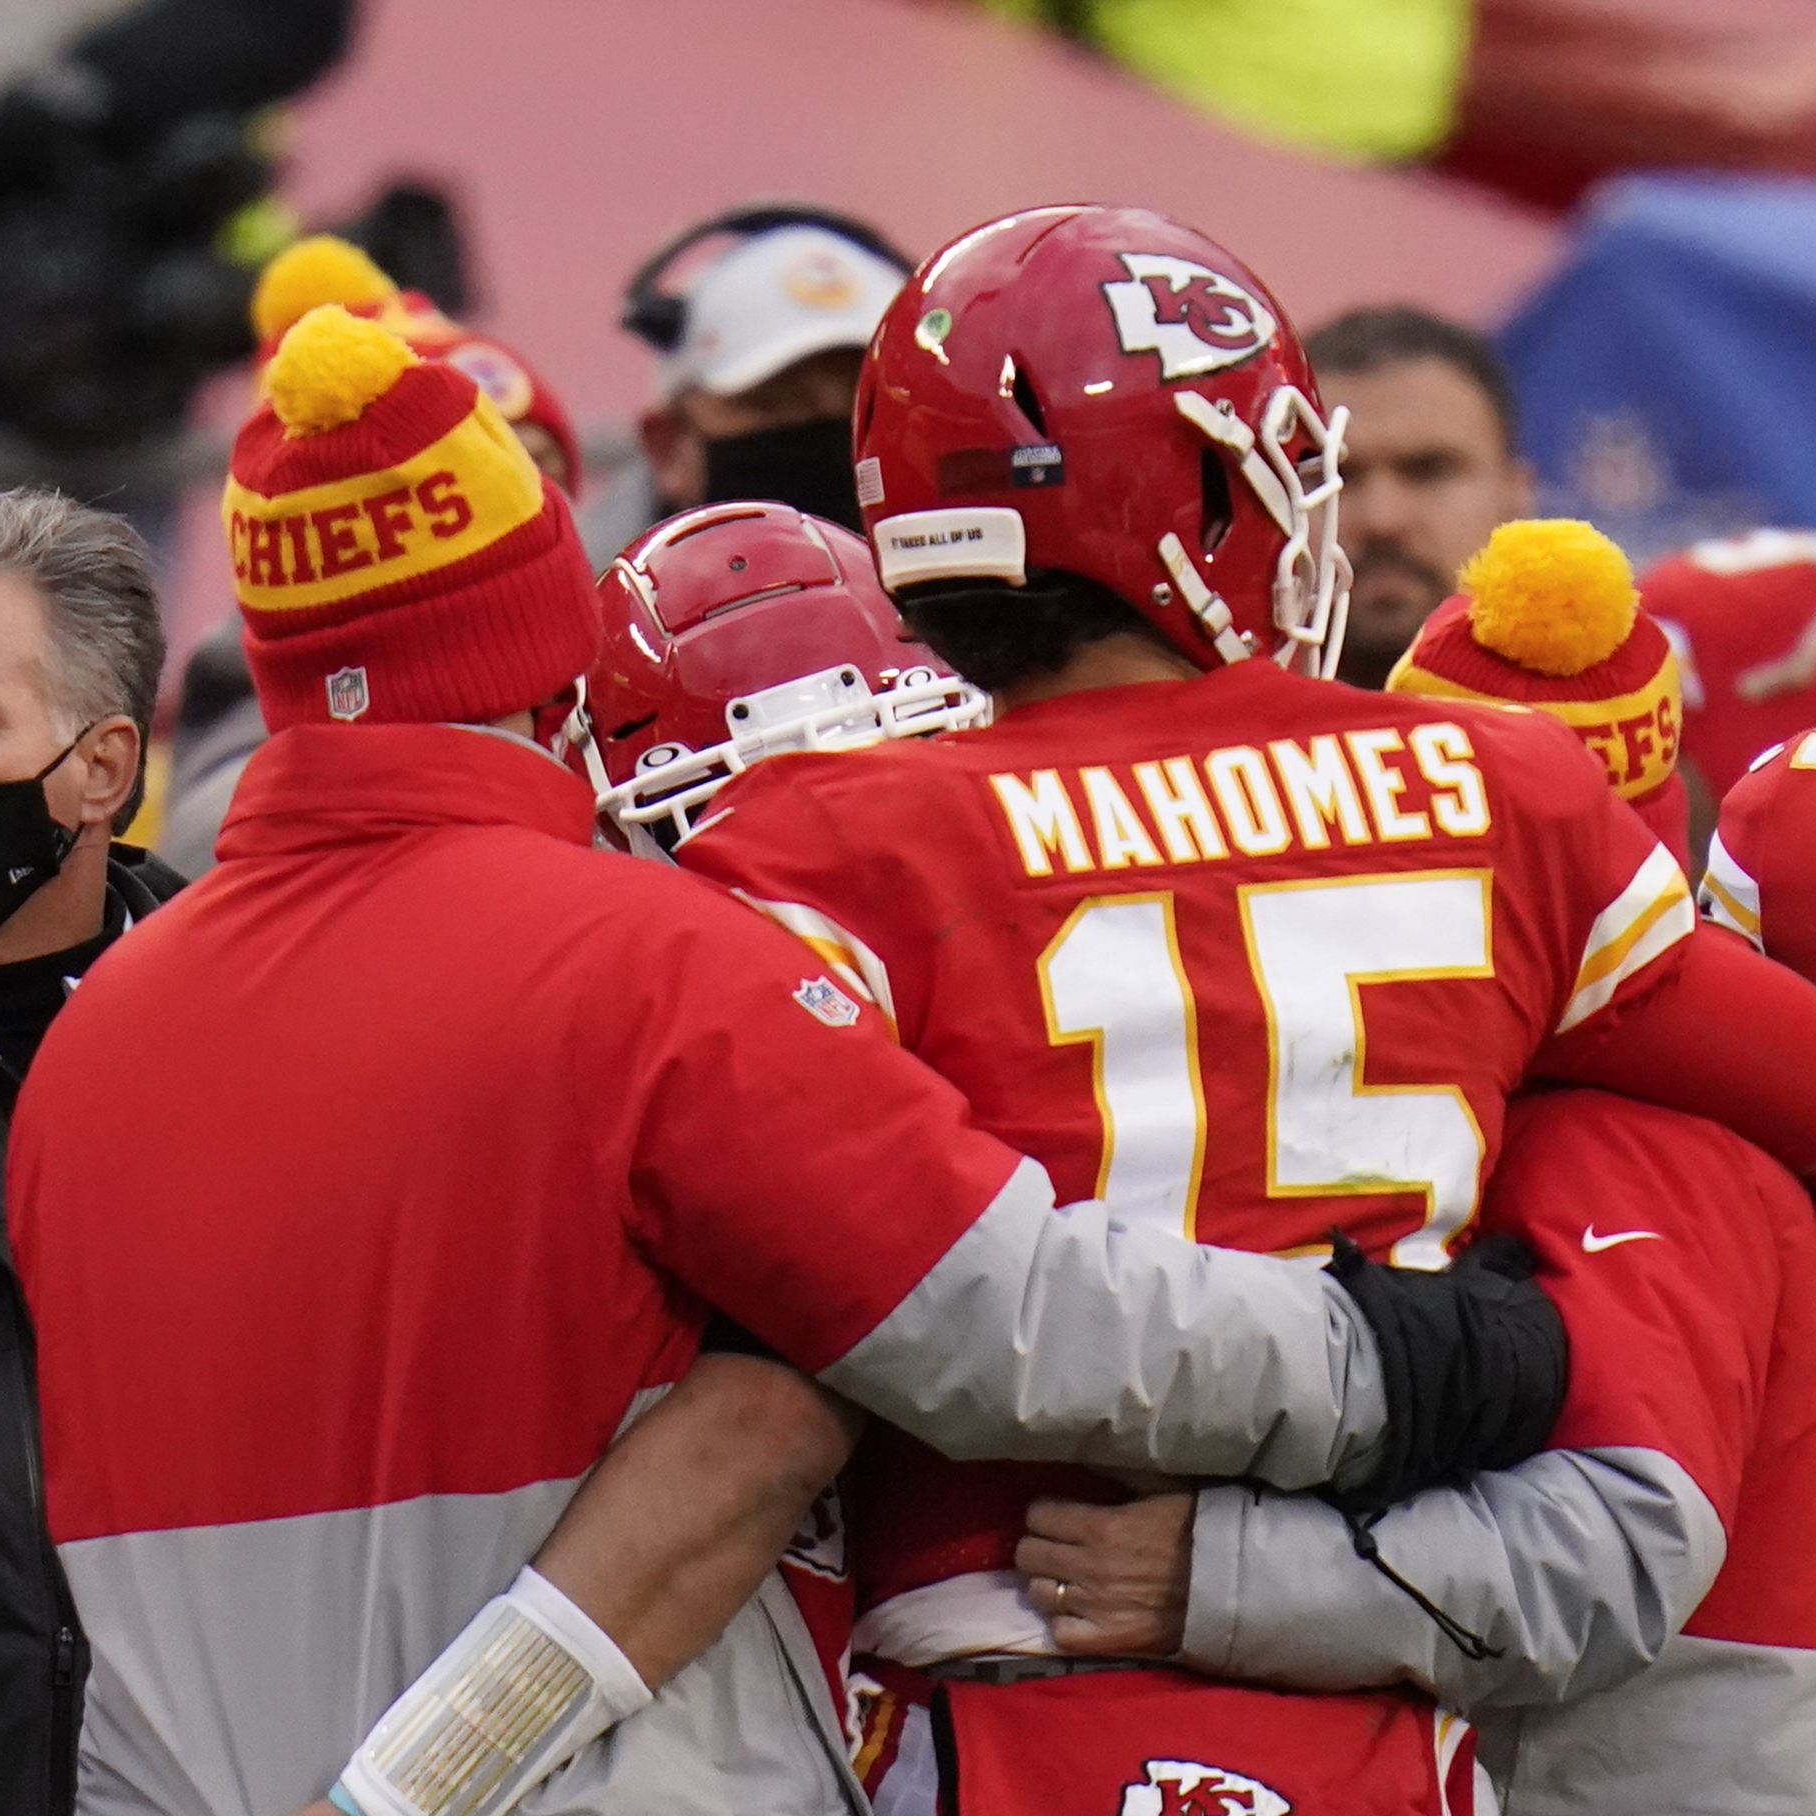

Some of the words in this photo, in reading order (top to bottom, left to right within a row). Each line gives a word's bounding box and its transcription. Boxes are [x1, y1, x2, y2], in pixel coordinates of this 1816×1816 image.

[231, 469, 473, 587] CHIEFS
[929, 533, 948, 545] ALL
[989, 721, 1491, 878] MAHOMES
[1037, 867, 1495, 1274] 15
